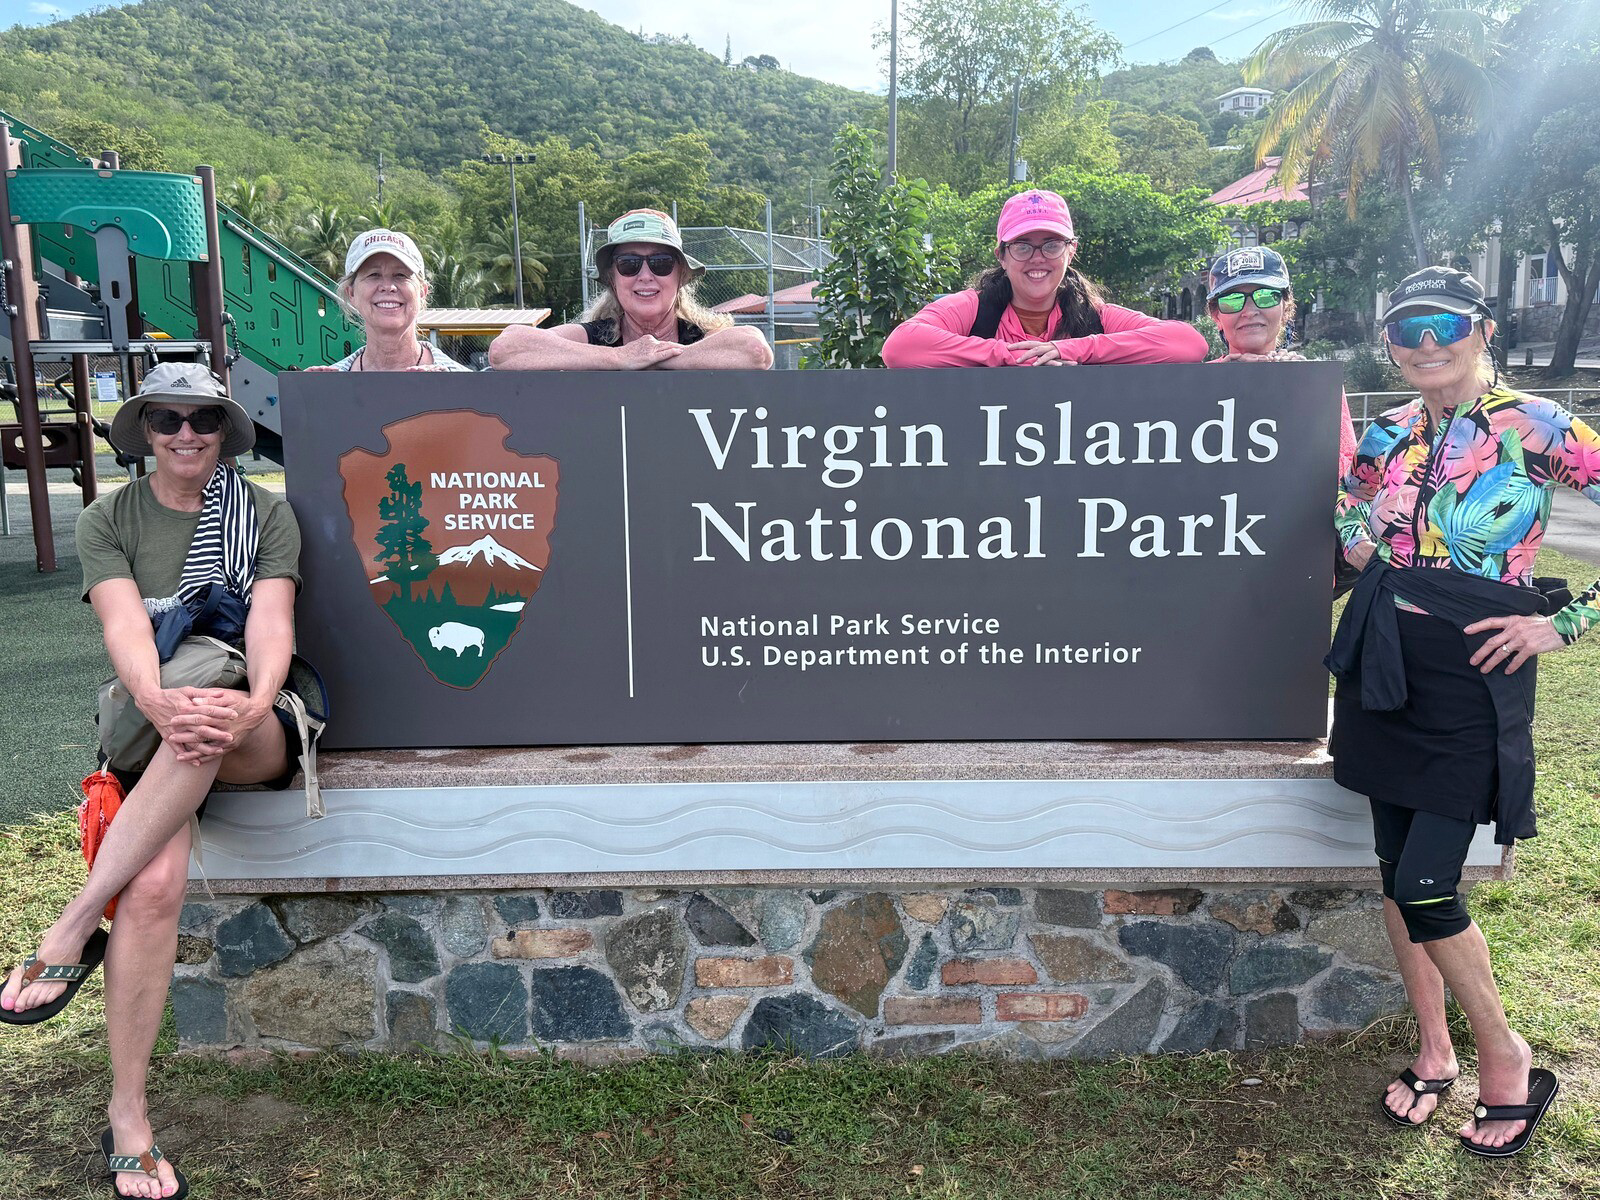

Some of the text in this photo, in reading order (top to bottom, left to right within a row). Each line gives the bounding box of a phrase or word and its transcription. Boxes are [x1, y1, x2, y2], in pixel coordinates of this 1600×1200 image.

[364, 235, 405, 248] CHICAGO
[244, 321, 256, 331] 13
[271, 338, 281, 347] 11
[298, 354, 304, 363] 7
[688, 398, 1279, 488] Virgin Islands
[430, 472, 545, 488] NATIONAL
[459, 493, 518, 509] PARK
[444, 513, 535, 530] SERVICE
[692, 492, 1266, 562] National Park
[701, 613, 1000, 637] National Park Service
[701, 642, 1142, 671] U.S. Department of the Interior
